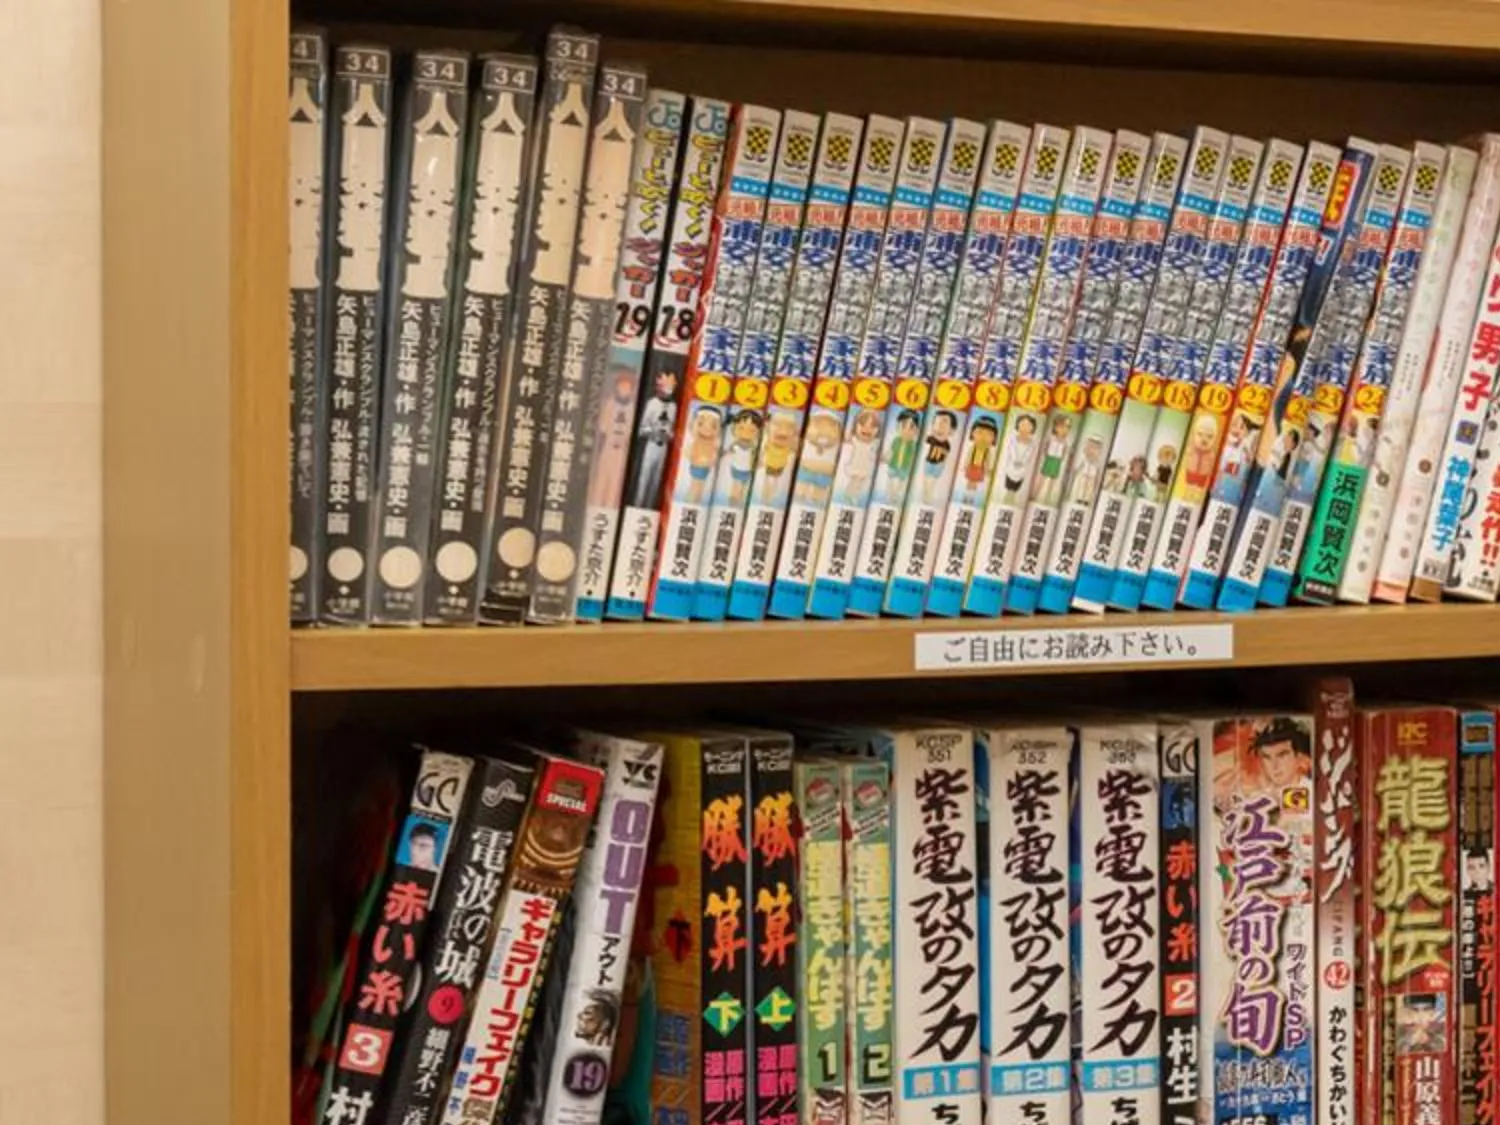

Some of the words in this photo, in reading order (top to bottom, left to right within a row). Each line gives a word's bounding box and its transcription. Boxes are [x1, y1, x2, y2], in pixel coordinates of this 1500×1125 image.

[345, 54, 380, 72] 34
[421, 62, 455, 81] 34
[556, 41, 588, 58] 34
[493, 68, 528, 87] 34
[604, 75, 637, 94] 34
[614, 303, 650, 340] 19
[658, 303, 696, 341] 18
[1313, 470, 1360, 576] 浜岡賢次
[943, 631, 1198, 664] ご自由にお読み下さい。
[602, 799, 652, 936] OUT
[1374, 754, 1455, 988] 龍狼伝
[436, 829, 515, 989] 電波の城
[907, 766, 979, 1061] 紫電改のタカ
[997, 767, 1068, 1063] 紫電改のタカ
[1087, 768, 1159, 1058] 紫電改のタカ
[1164, 840, 1198, 961] 赤い糸
[359, 881, 431, 1017] 赤い糸
[1217, 796, 1288, 1057] 江戸前の旬
[595, 937, 622, 986] アウト
[469, 896, 554, 1099] ギャラリーフェイク
[715, 999, 741, 1030] 下
[346, 1030, 386, 1072] 3
[569, 1062, 601, 1090] 19
